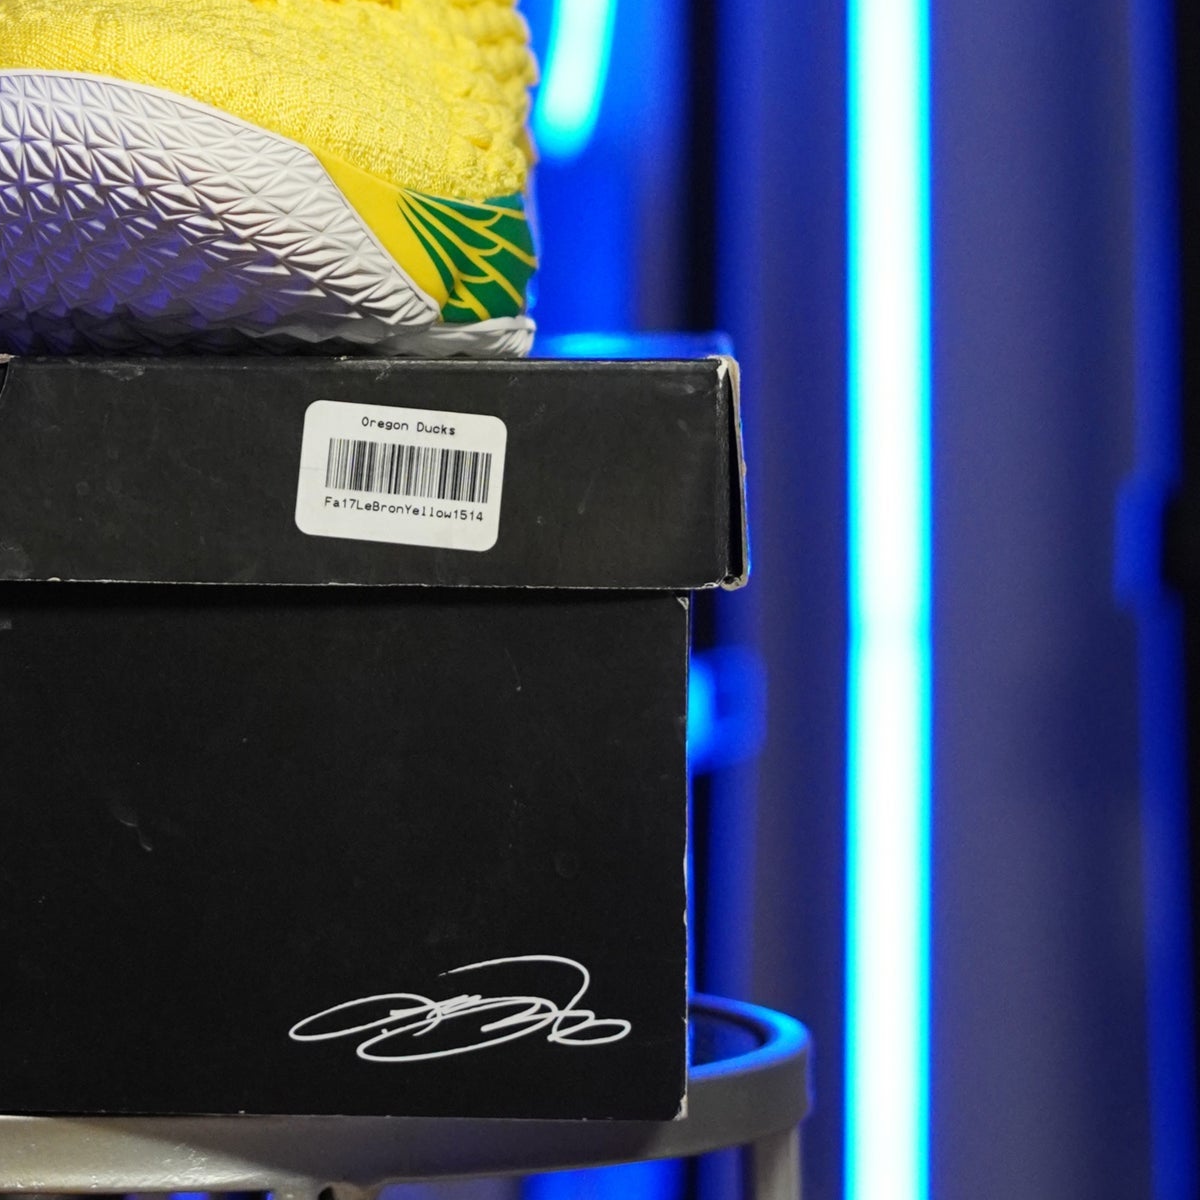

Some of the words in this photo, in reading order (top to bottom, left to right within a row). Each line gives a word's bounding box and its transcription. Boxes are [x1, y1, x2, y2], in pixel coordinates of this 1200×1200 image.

[361, 416, 409, 431] Oregon
[416, 421, 456, 436] Ducks
[324, 496, 484, 522] Fa17LeBronYellow1514
